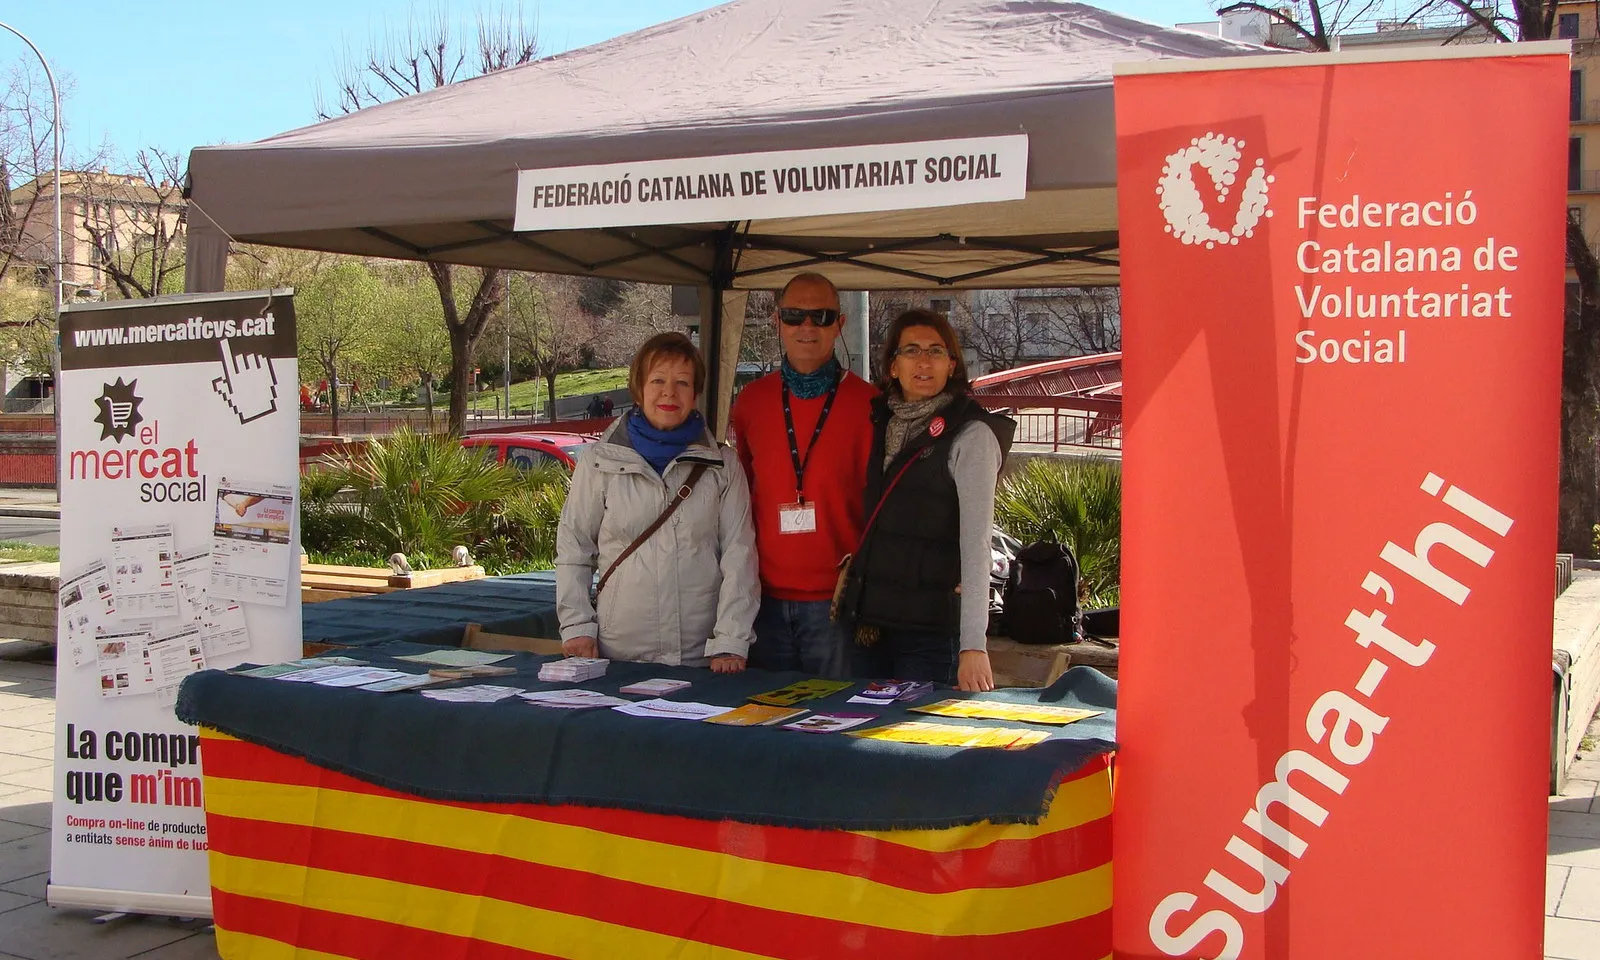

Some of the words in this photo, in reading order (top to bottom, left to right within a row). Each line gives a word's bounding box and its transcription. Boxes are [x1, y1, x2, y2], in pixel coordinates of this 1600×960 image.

[533, 173, 632, 208] FEDERACIÓ
[638, 173, 735, 203] CATALANA
[740, 170, 767, 196] DE
[773, 159, 918, 194] VOLUNTARIAT
[924, 153, 1001, 184] SOCIAL
[1297, 190, 1477, 229] Federació
[1296, 240, 1461, 274] Catalana
[1473, 237, 1518, 272] de
[1294, 283, 1512, 319] Voluntariat
[75, 312, 275, 347] www.mercatfcvs.cat
[1294, 329, 1406, 364] Social
[140, 420, 158, 445] el
[70, 438, 198, 480] mercat
[140, 475, 206, 503] social
[67, 723, 97, 760] La
[66, 770, 123, 805] que
[130, 769, 205, 812] m'im
[66, 815, 106, 830] Compra
[109, 818, 145, 831] on-line
[147, 820, 160, 832] de
[162, 822, 207, 835] producte
[66, 833, 73, 843] a
[75, 832, 113, 845] entitats
[115, 835, 146, 847] sense
[148, 836, 174, 849] ànim
[176, 839, 189, 850] de
